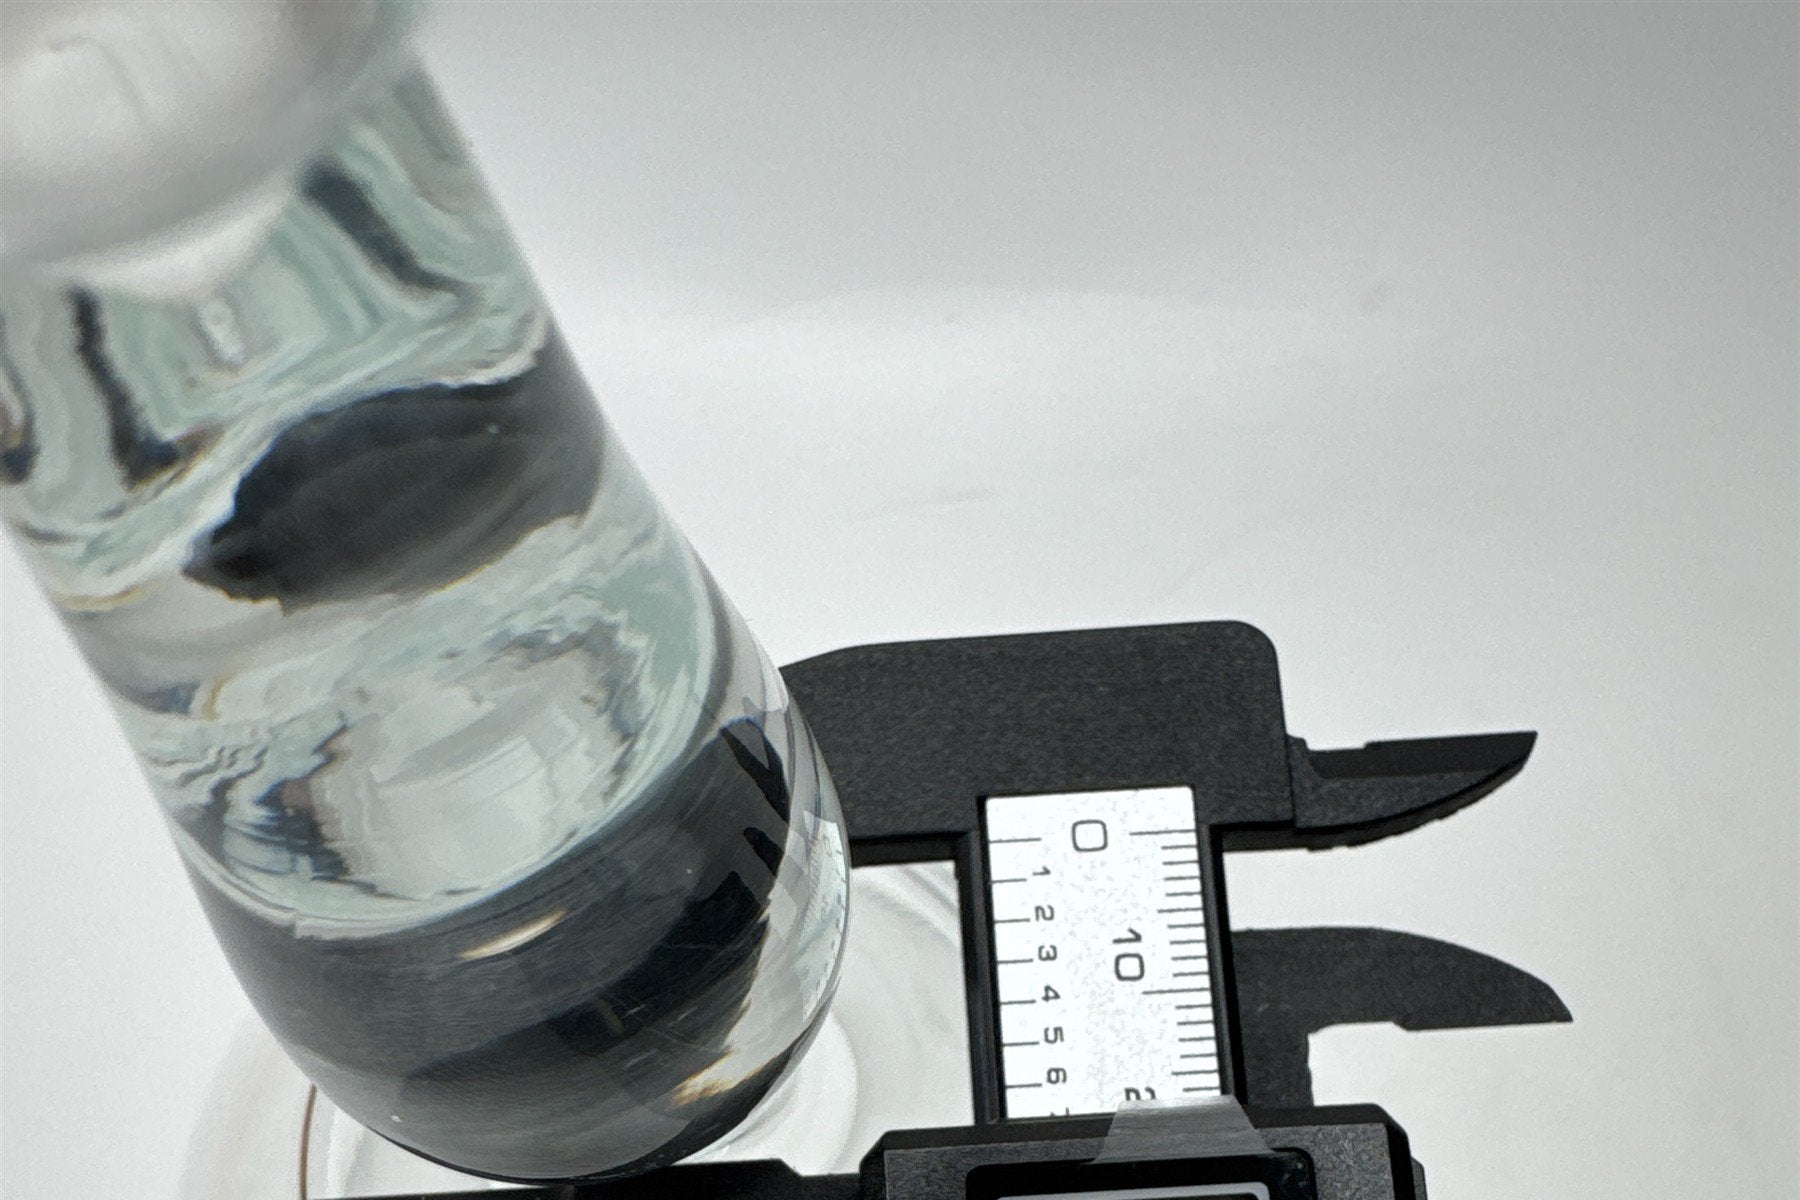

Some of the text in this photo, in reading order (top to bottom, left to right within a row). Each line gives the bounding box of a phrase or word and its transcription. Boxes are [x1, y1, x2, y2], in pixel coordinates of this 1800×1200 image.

[1071, 819, 1108, 853] 0
[1032, 866, 1052, 877] 1
[1034, 905, 1055, 922] 2
[1038, 945, 1058, 962] 3
[1112, 927, 1145, 982] 10
[1041, 985, 1061, 1002] 4
[1044, 1026, 1064, 1044] 5
[1046, 1067, 1067, 1085] 6
